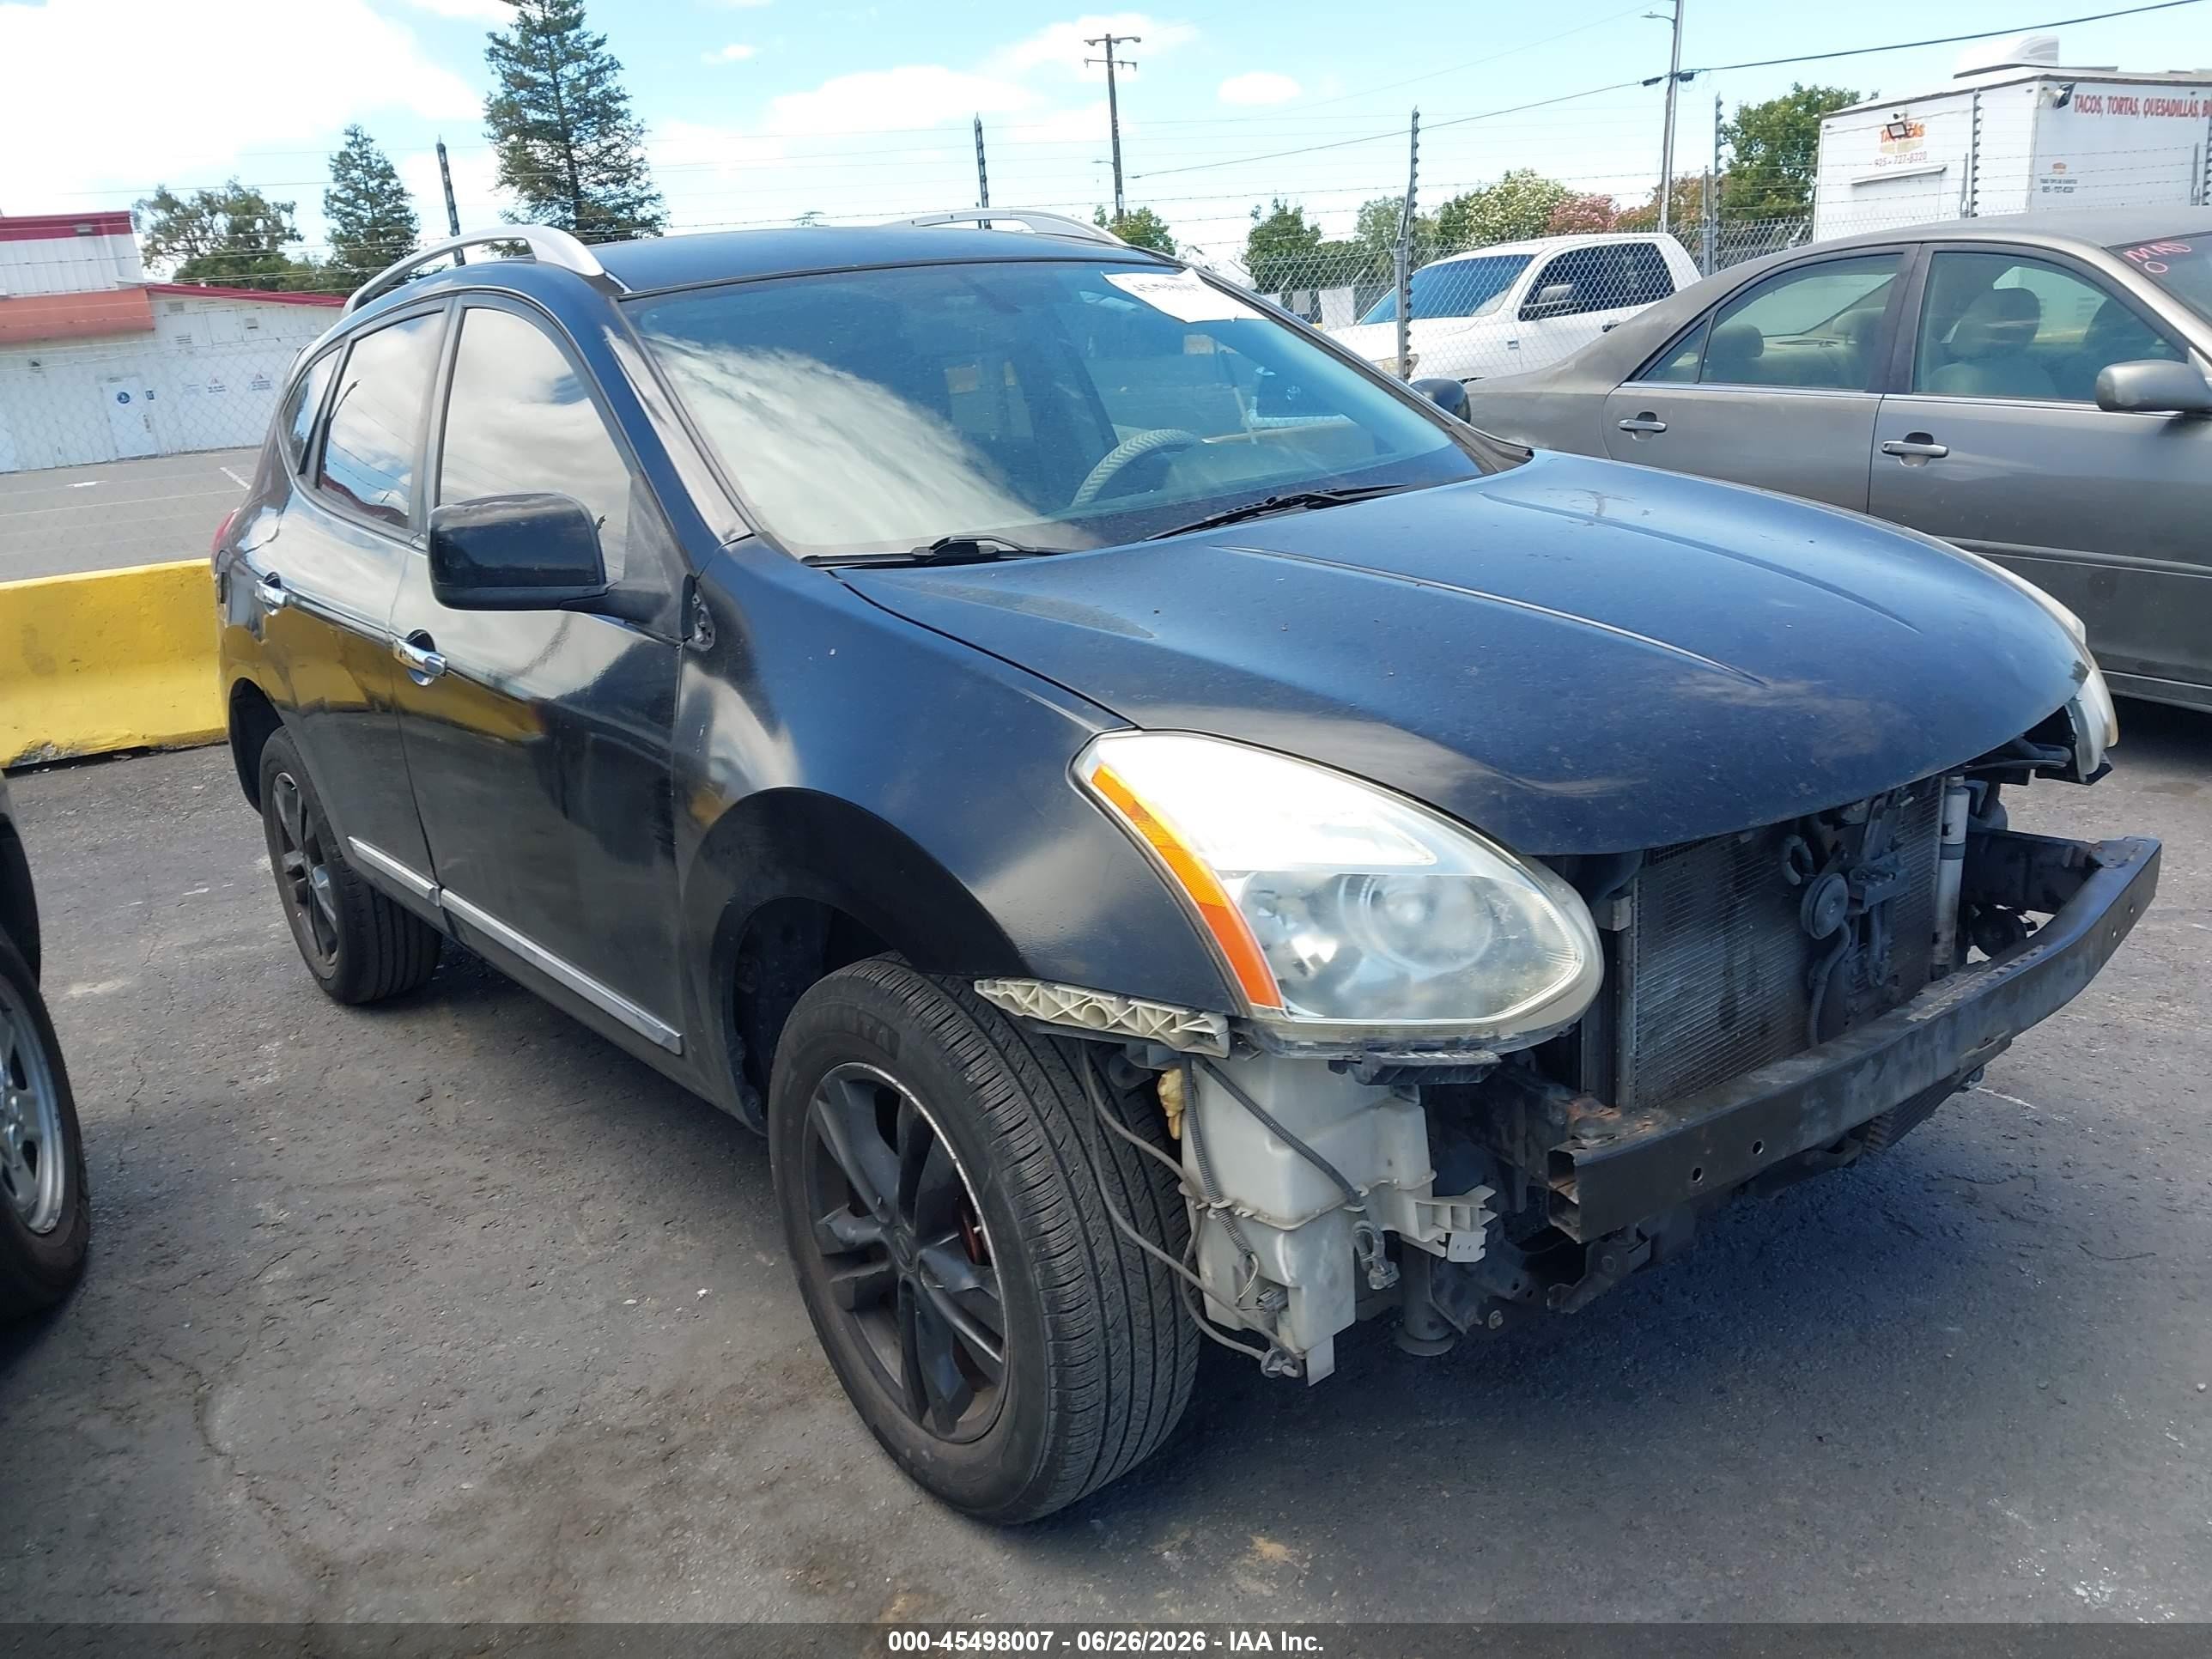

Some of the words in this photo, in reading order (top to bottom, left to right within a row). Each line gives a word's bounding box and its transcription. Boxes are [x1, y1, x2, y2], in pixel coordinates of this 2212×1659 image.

[2074, 94, 2104, 117] TACOS,
[2107, 95, 2140, 118] TORTAS,
[2143, 97, 2199, 120] QUESADILLAS,
